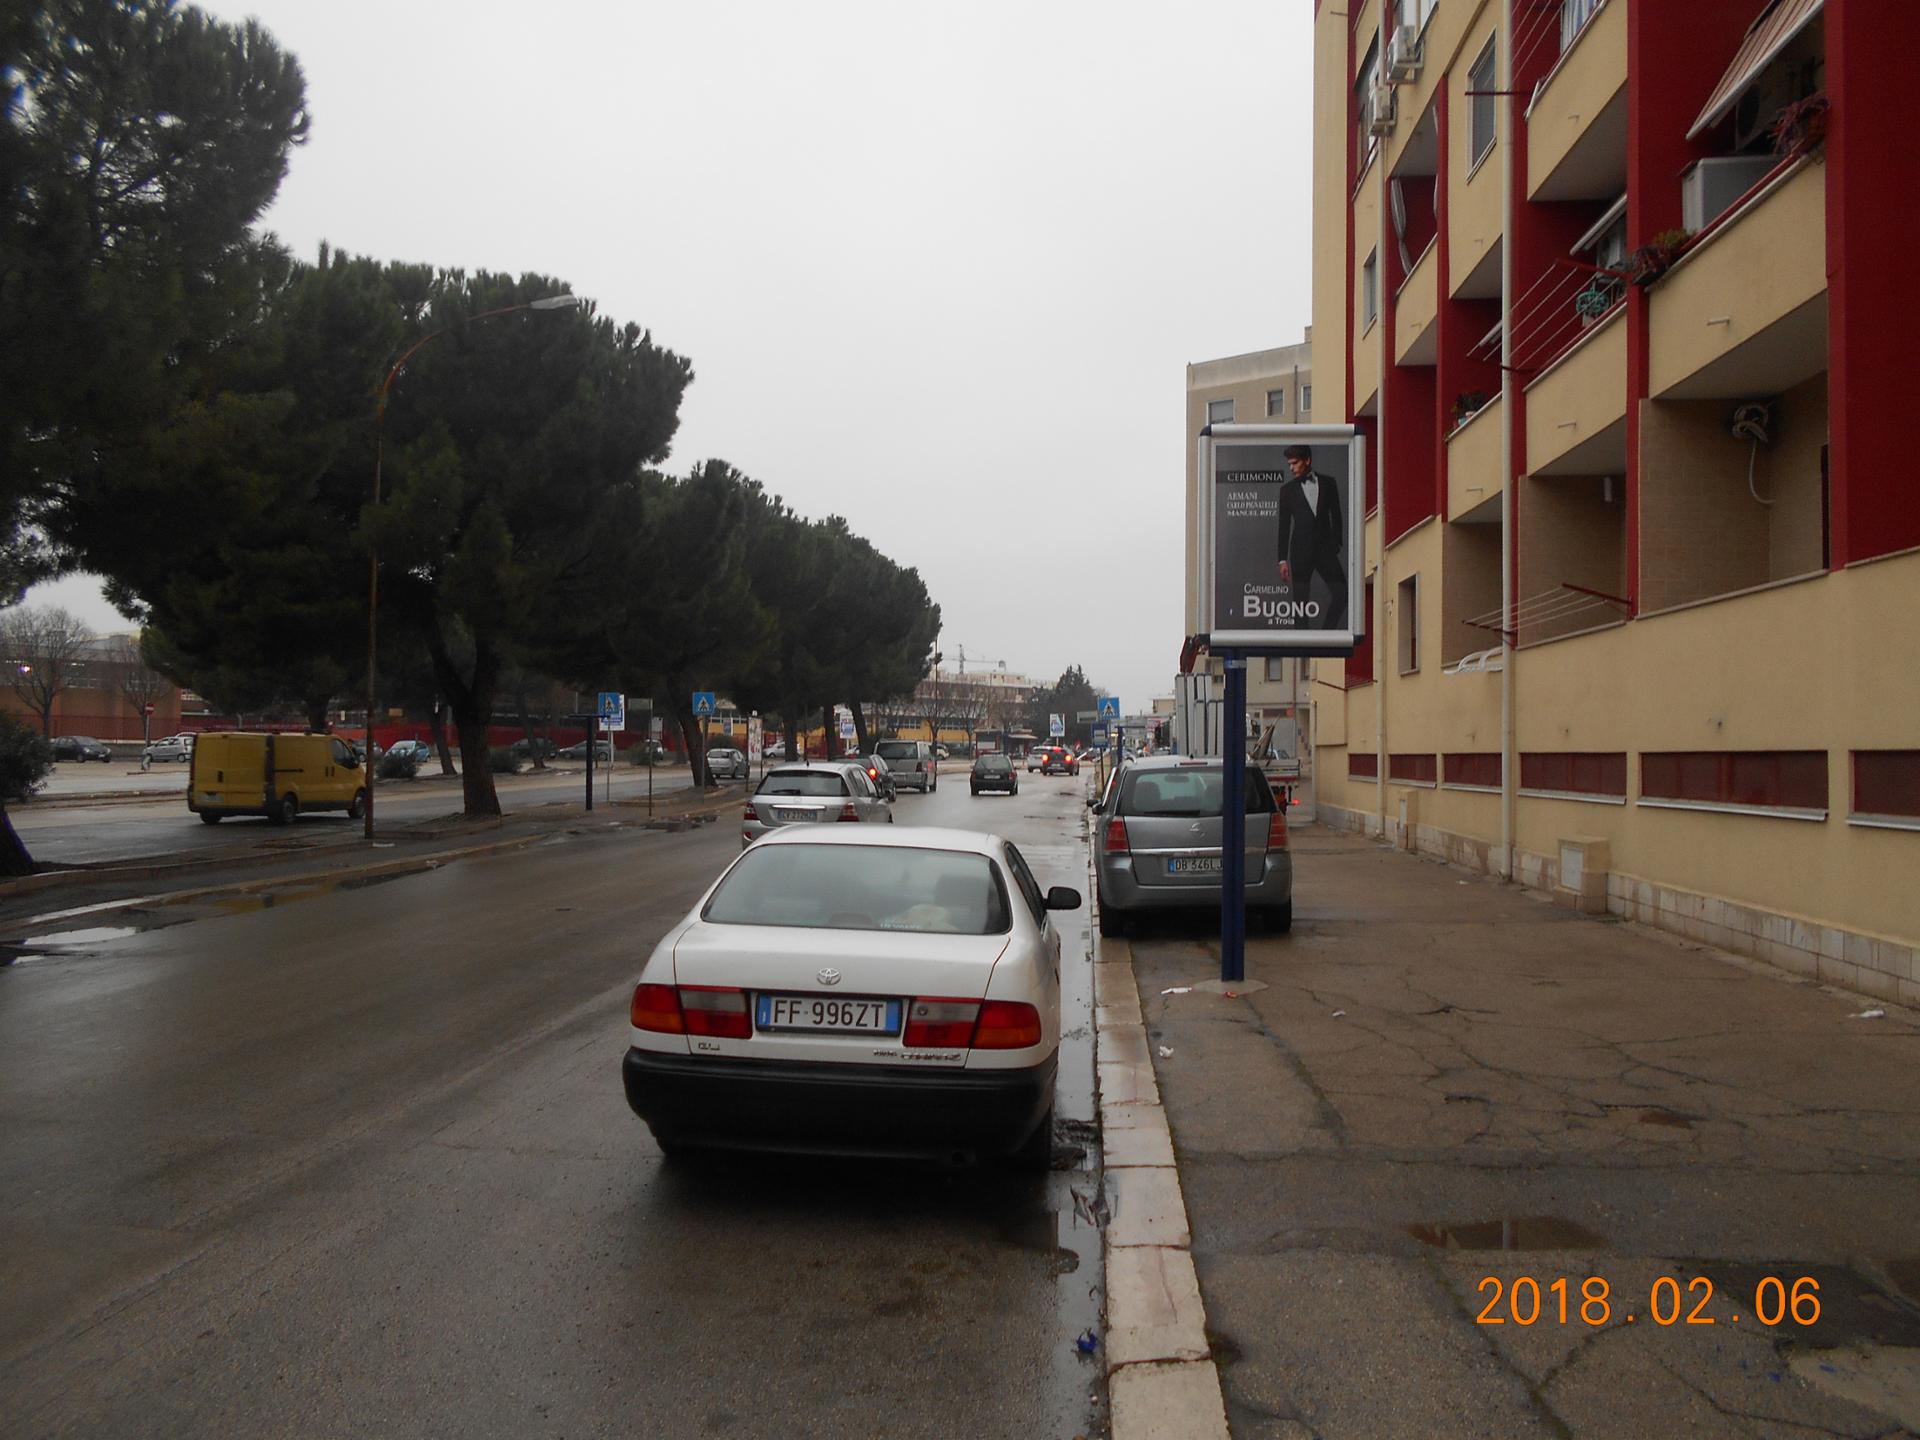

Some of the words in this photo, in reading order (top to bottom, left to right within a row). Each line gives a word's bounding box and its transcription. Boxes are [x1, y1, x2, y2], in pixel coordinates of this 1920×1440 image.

[1227, 472, 1283, 481] CERIMONIA
[1228, 491, 1258, 500] ARMANI
[1243, 582, 1289, 594] CARMELINO
[1243, 595, 1320, 618] BUONO
[1275, 617, 1295, 625] Troia
[1175, 859, 1188, 871] DB
[774, 999, 802, 1024] FF
[812, 1001, 884, 1028] 996ZT
